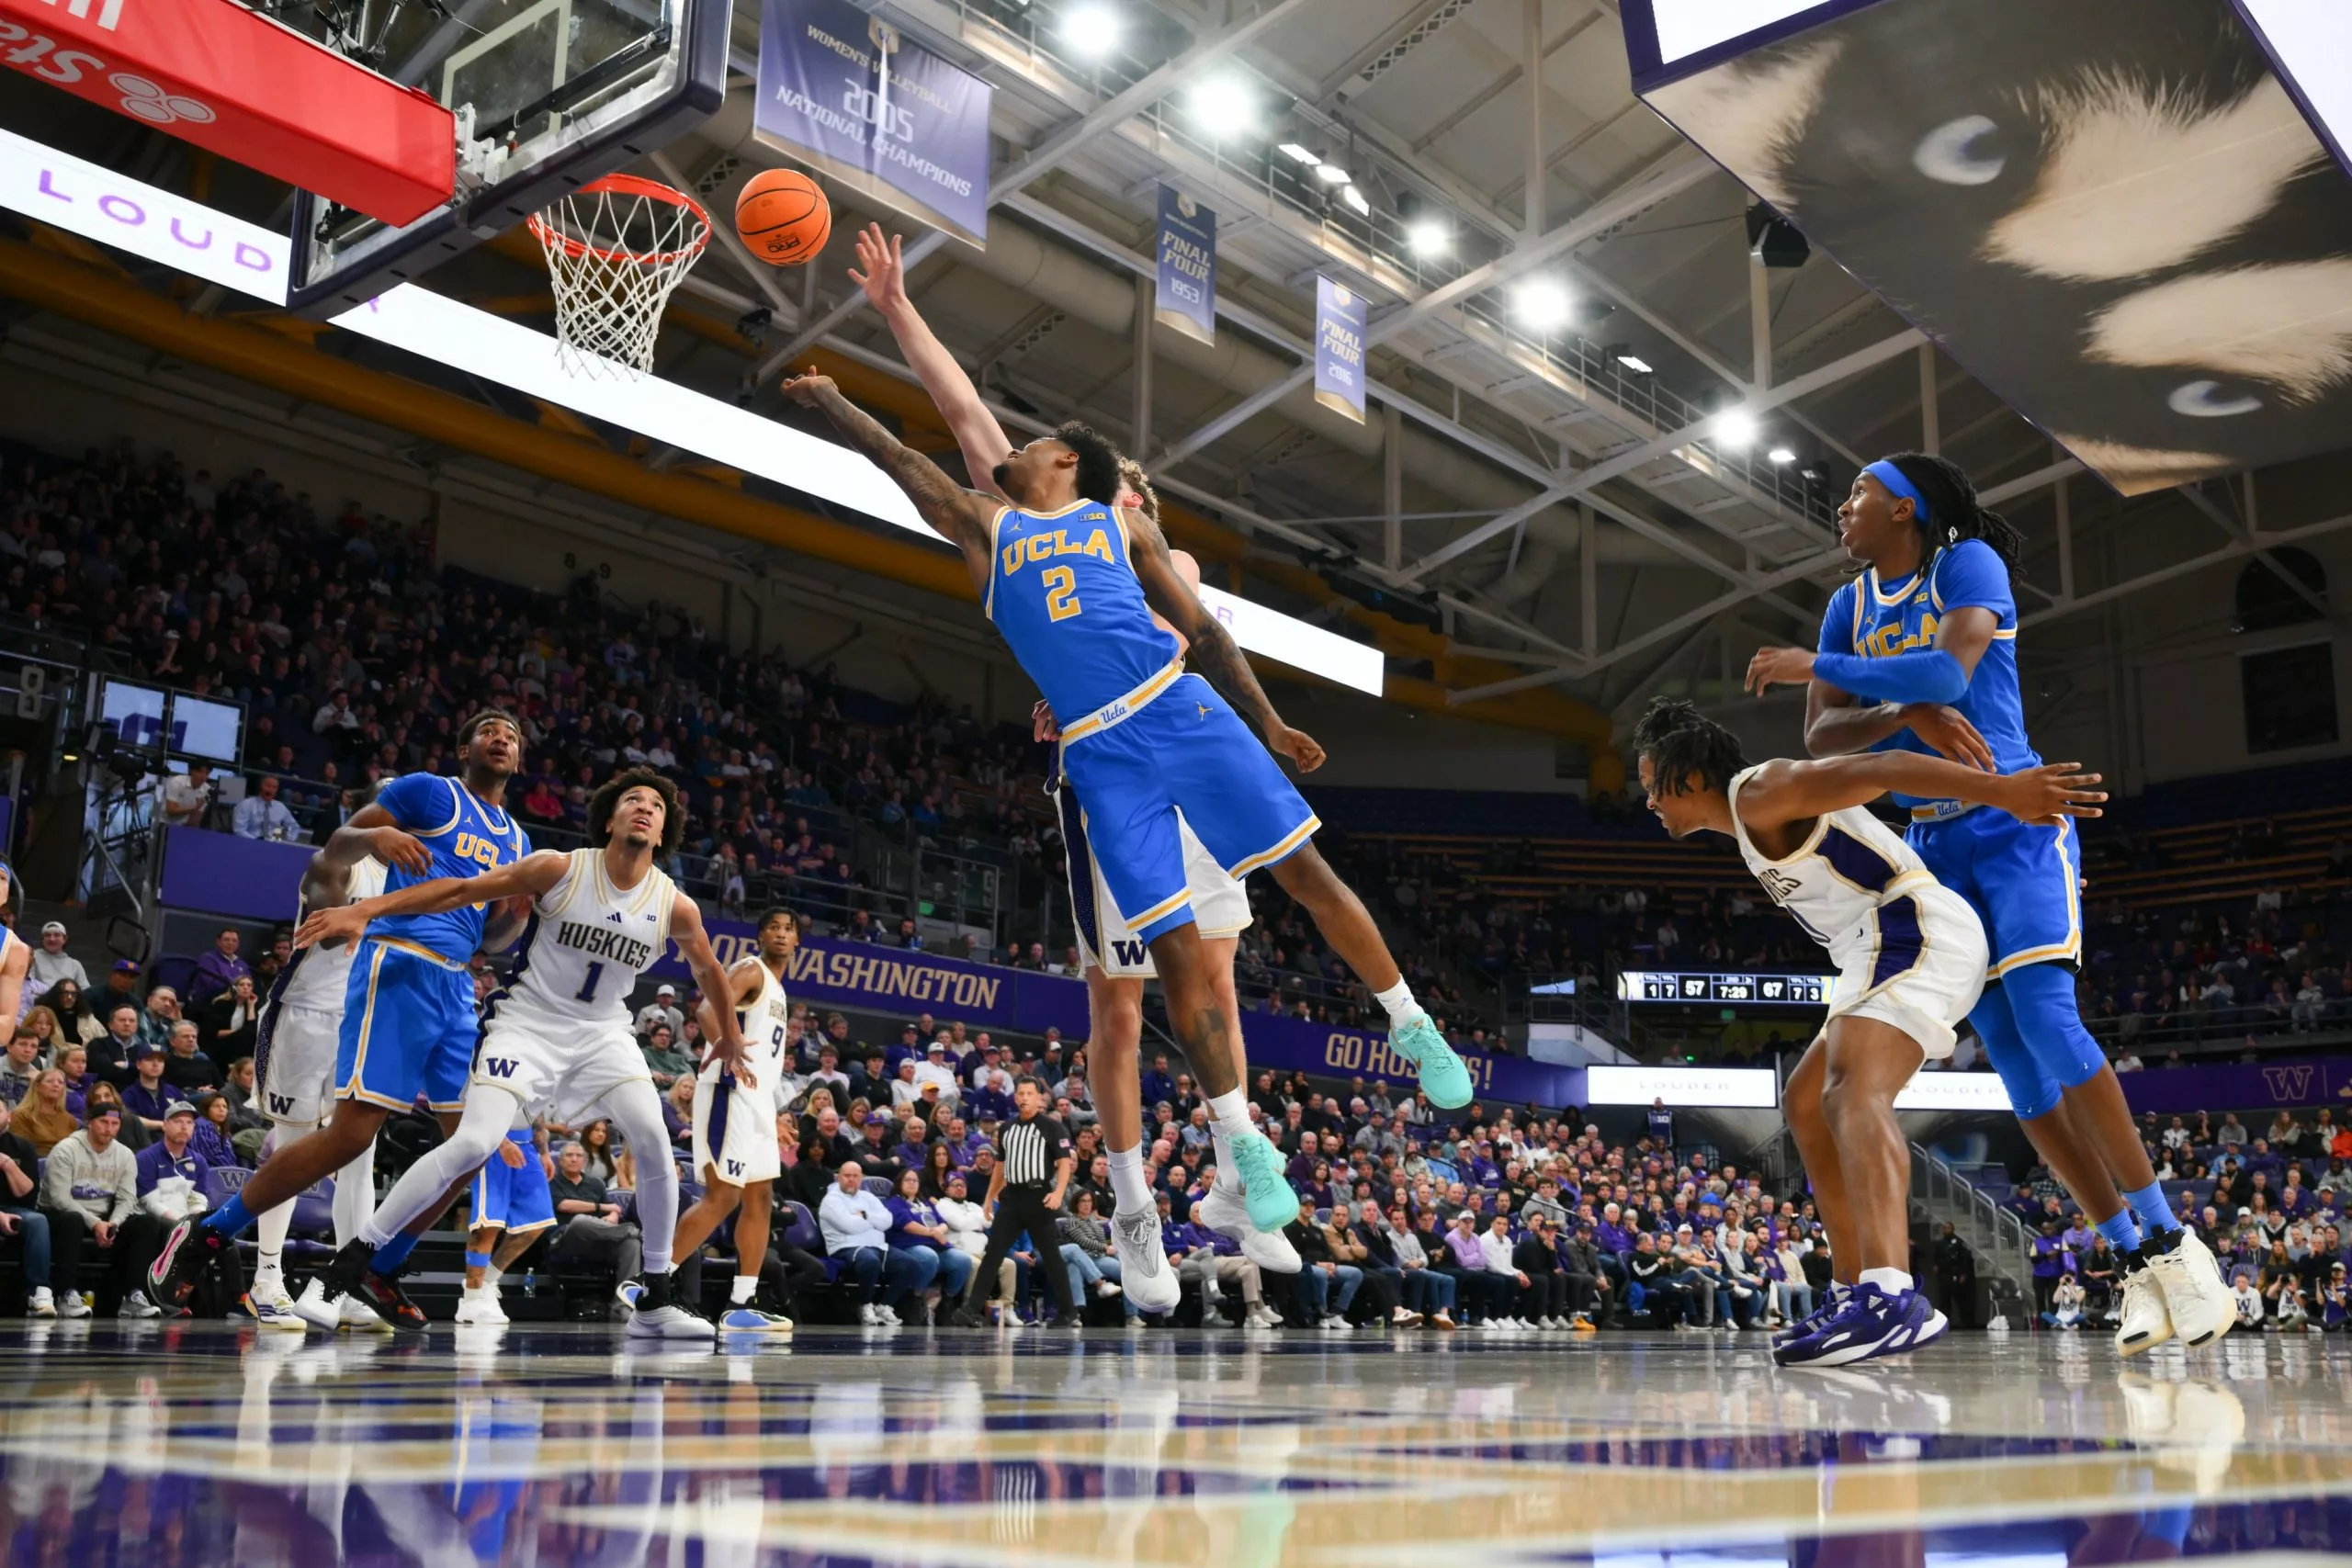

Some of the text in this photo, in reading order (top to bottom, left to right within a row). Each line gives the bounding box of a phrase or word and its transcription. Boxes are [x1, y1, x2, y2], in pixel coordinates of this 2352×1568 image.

[808, 25, 951, 114] WOMEN'S VLLEYBALL
[843, 77, 915, 143] 2005
[775, 85, 972, 197] NATIONAL CHAMPIONS
[1161, 230, 1211, 268] FINAL
[1163, 248, 1209, 284] FOUR
[1170, 277, 1199, 304] 1953
[1321, 317, 1362, 353] FINAL
[1322, 334, 1360, 367] FOUR
[1329, 361, 1352, 387] 2016
[1001, 529, 1114, 577] UCLA
[1041, 565, 1082, 623] 2
[1101, 704, 1127, 724] Ucla
[1937, 801, 1960, 816] Ucla
[454, 832, 514, 870] UCL
[556, 921, 651, 969] HUSKIES
[1111, 940, 1148, 967] W
[575, 960, 605, 1003] 1
[1649, 984, 1657, 998] 1
[1665, 984, 1675, 998] 7
[1685, 980, 1706, 997] 57
[1762, 982, 1783, 998] 67
[1792, 987, 1803, 1000] 7
[1810, 987, 1820, 1001] 3
[771, 1024, 785, 1058] 9
[1325, 1032, 1363, 1070] GO
[485, 1057, 519, 1078] W
[1639, 1079, 1731, 1090] LOUDER
[1912, 1085, 1999, 1095] LOUDER
[2261, 1066, 2313, 1100] W
[268, 1092, 295, 1115] W
[219, 1169, 246, 1190] W
[727, 1158, 745, 1177] W
